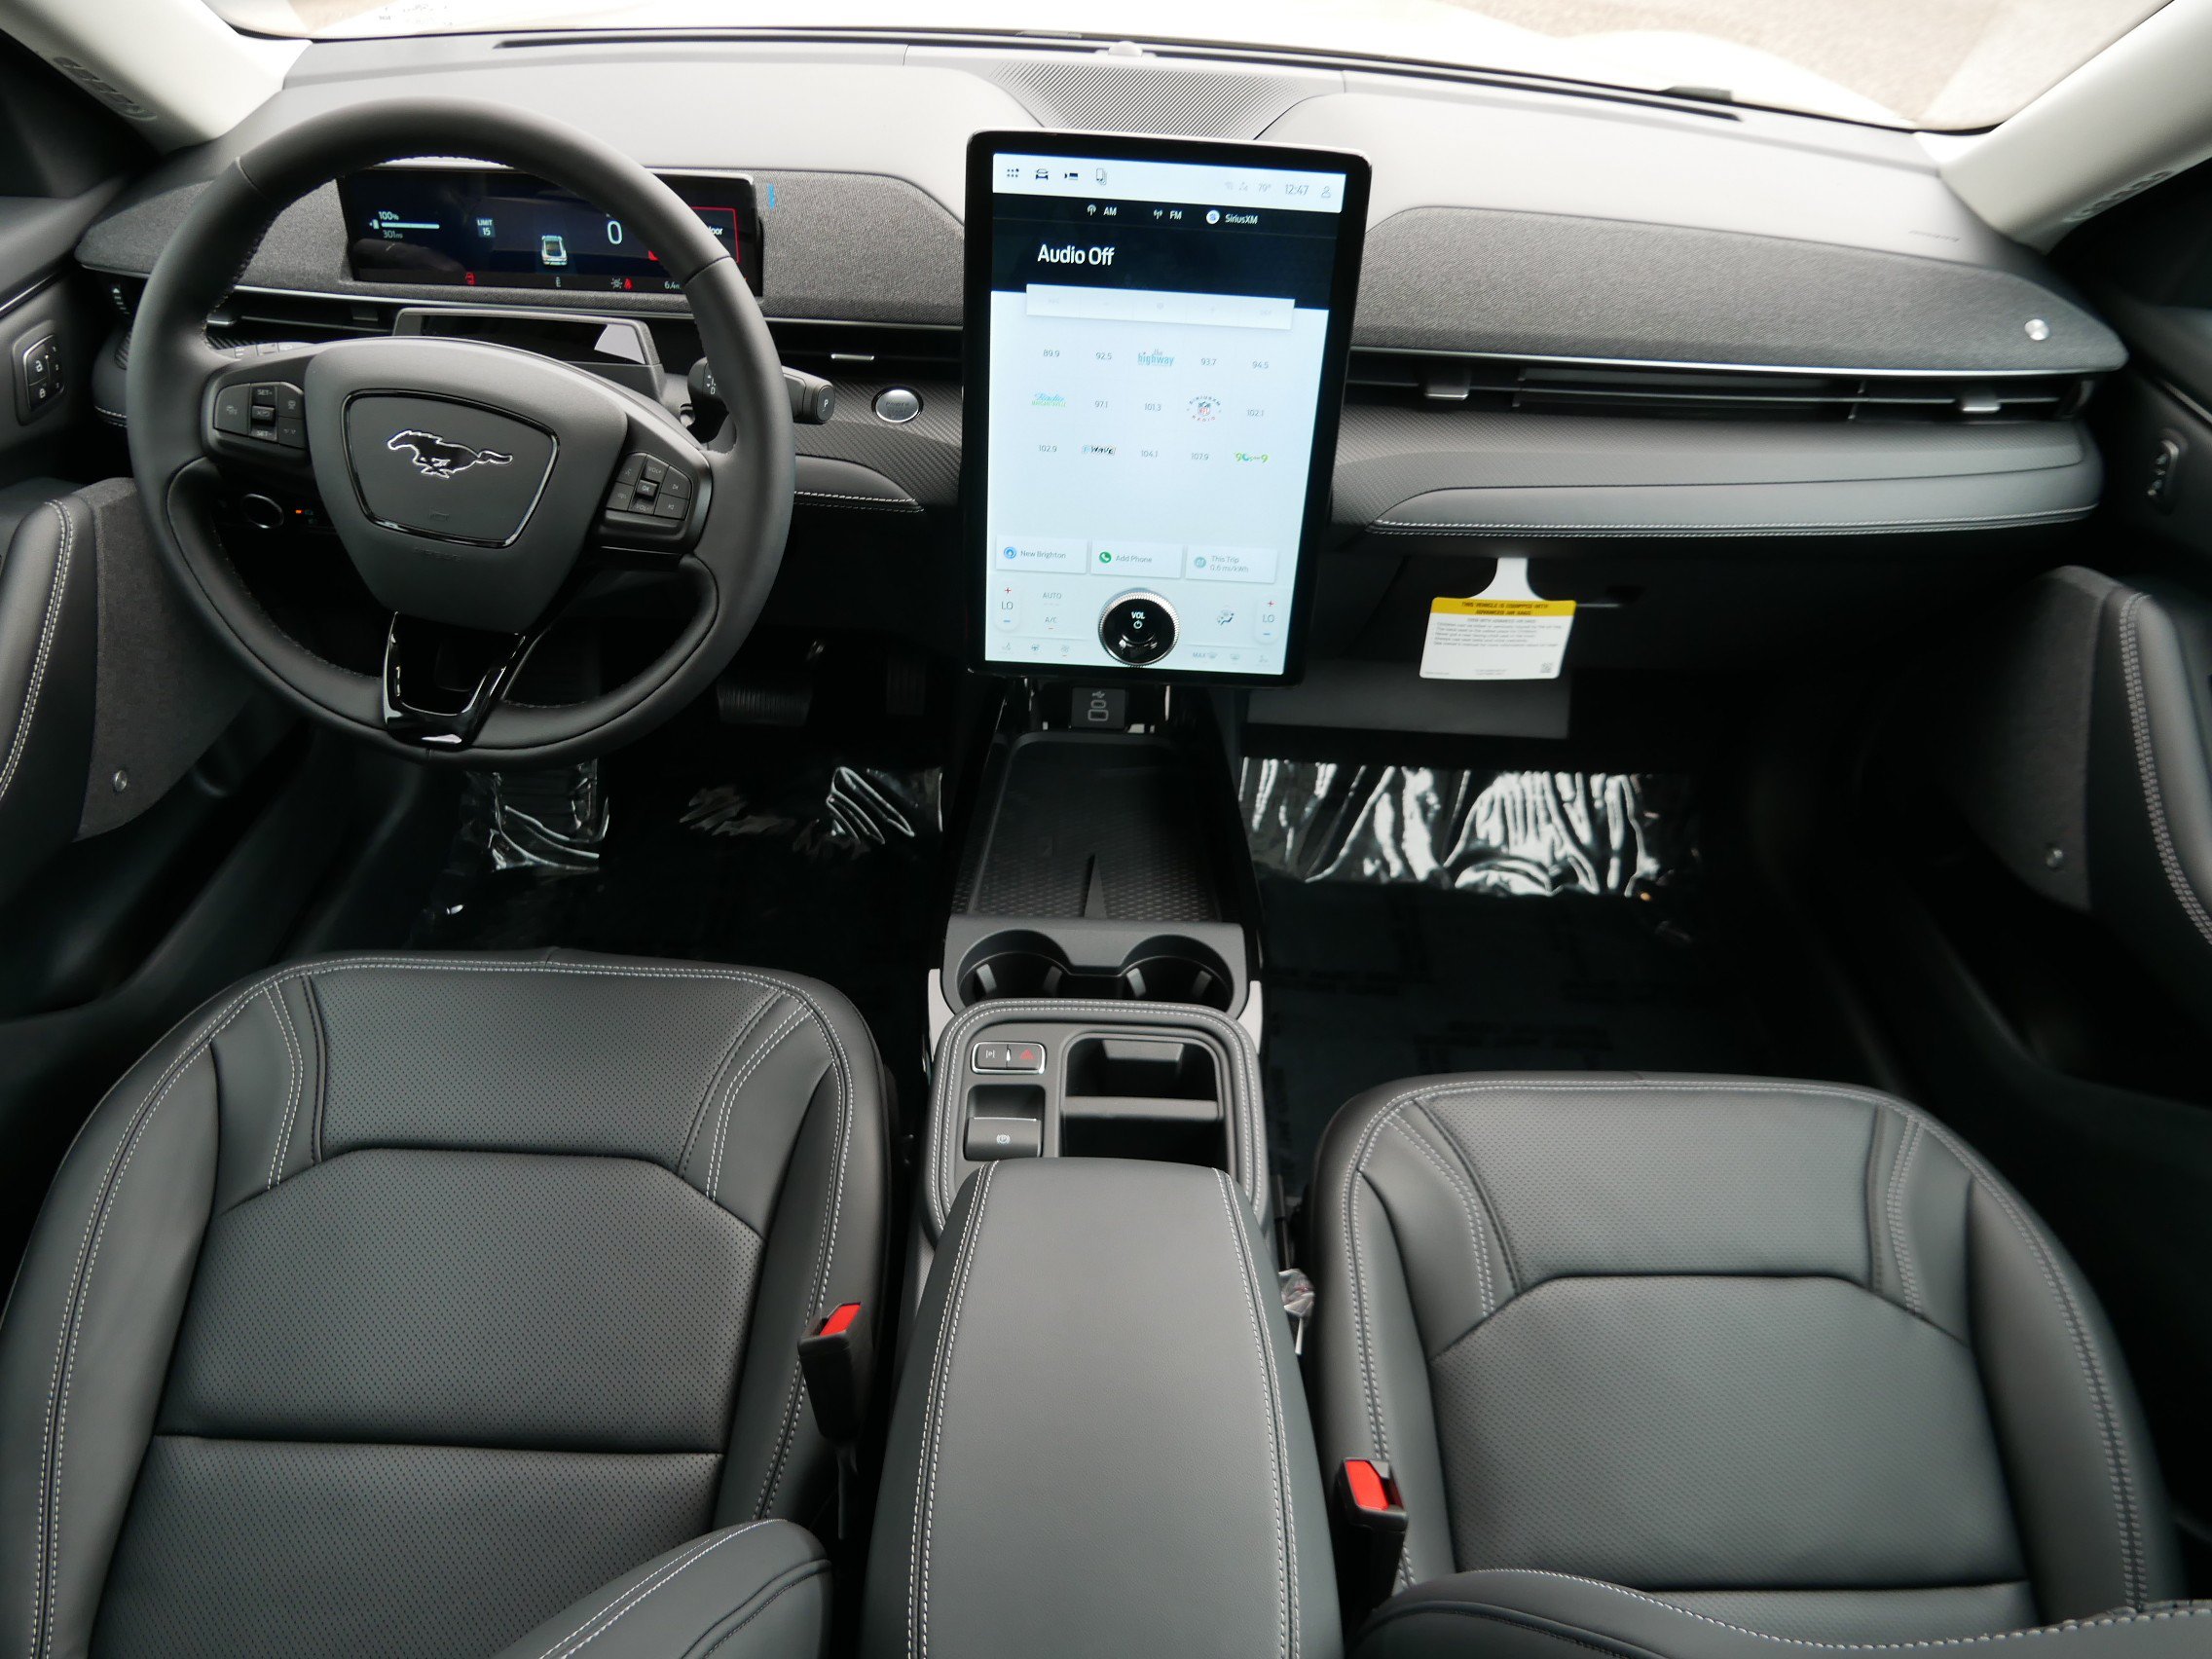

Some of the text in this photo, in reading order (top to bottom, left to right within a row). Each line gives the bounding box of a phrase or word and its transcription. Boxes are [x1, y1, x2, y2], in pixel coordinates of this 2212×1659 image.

[1284, 183, 1309, 196] 12:47
[378, 210, 399, 221] 100%
[1103, 206, 1117, 217] AM
[1169, 210, 1182, 221] FM
[1225, 213, 1258, 225] SiriusXM
[482, 227, 491, 237] 15
[607, 220, 623, 245] 0
[1037, 242, 1115, 266] Audio Off
[1043, 349, 1060, 358] 89.9
[1095, 351, 1113, 361] 92.5
[1137, 352, 1175, 367] highway
[1200, 357, 1217, 367] 93.7
[1252, 360, 1270, 370] 94.5
[1094, 399, 1109, 409] 97.1
[1144, 402, 1162, 413] 101.3
[1246, 408, 1265, 418] 102.1
[1038, 445, 1057, 454] 102.9
[1141, 449, 1159, 459] 104.1
[1191, 452, 1209, 461] 107.9
[1020, 549, 1067, 561] New Brighton
[1116, 554, 1153, 565] Add Phone
[1211, 555, 1239, 567] This Trip
[1042, 591, 1062, 600] AUTO
[1001, 601, 1014, 610] LO
[1045, 615, 1057, 624] A/C
[1131, 611, 1145, 620] VOL
[1262, 613, 1275, 623] LO
